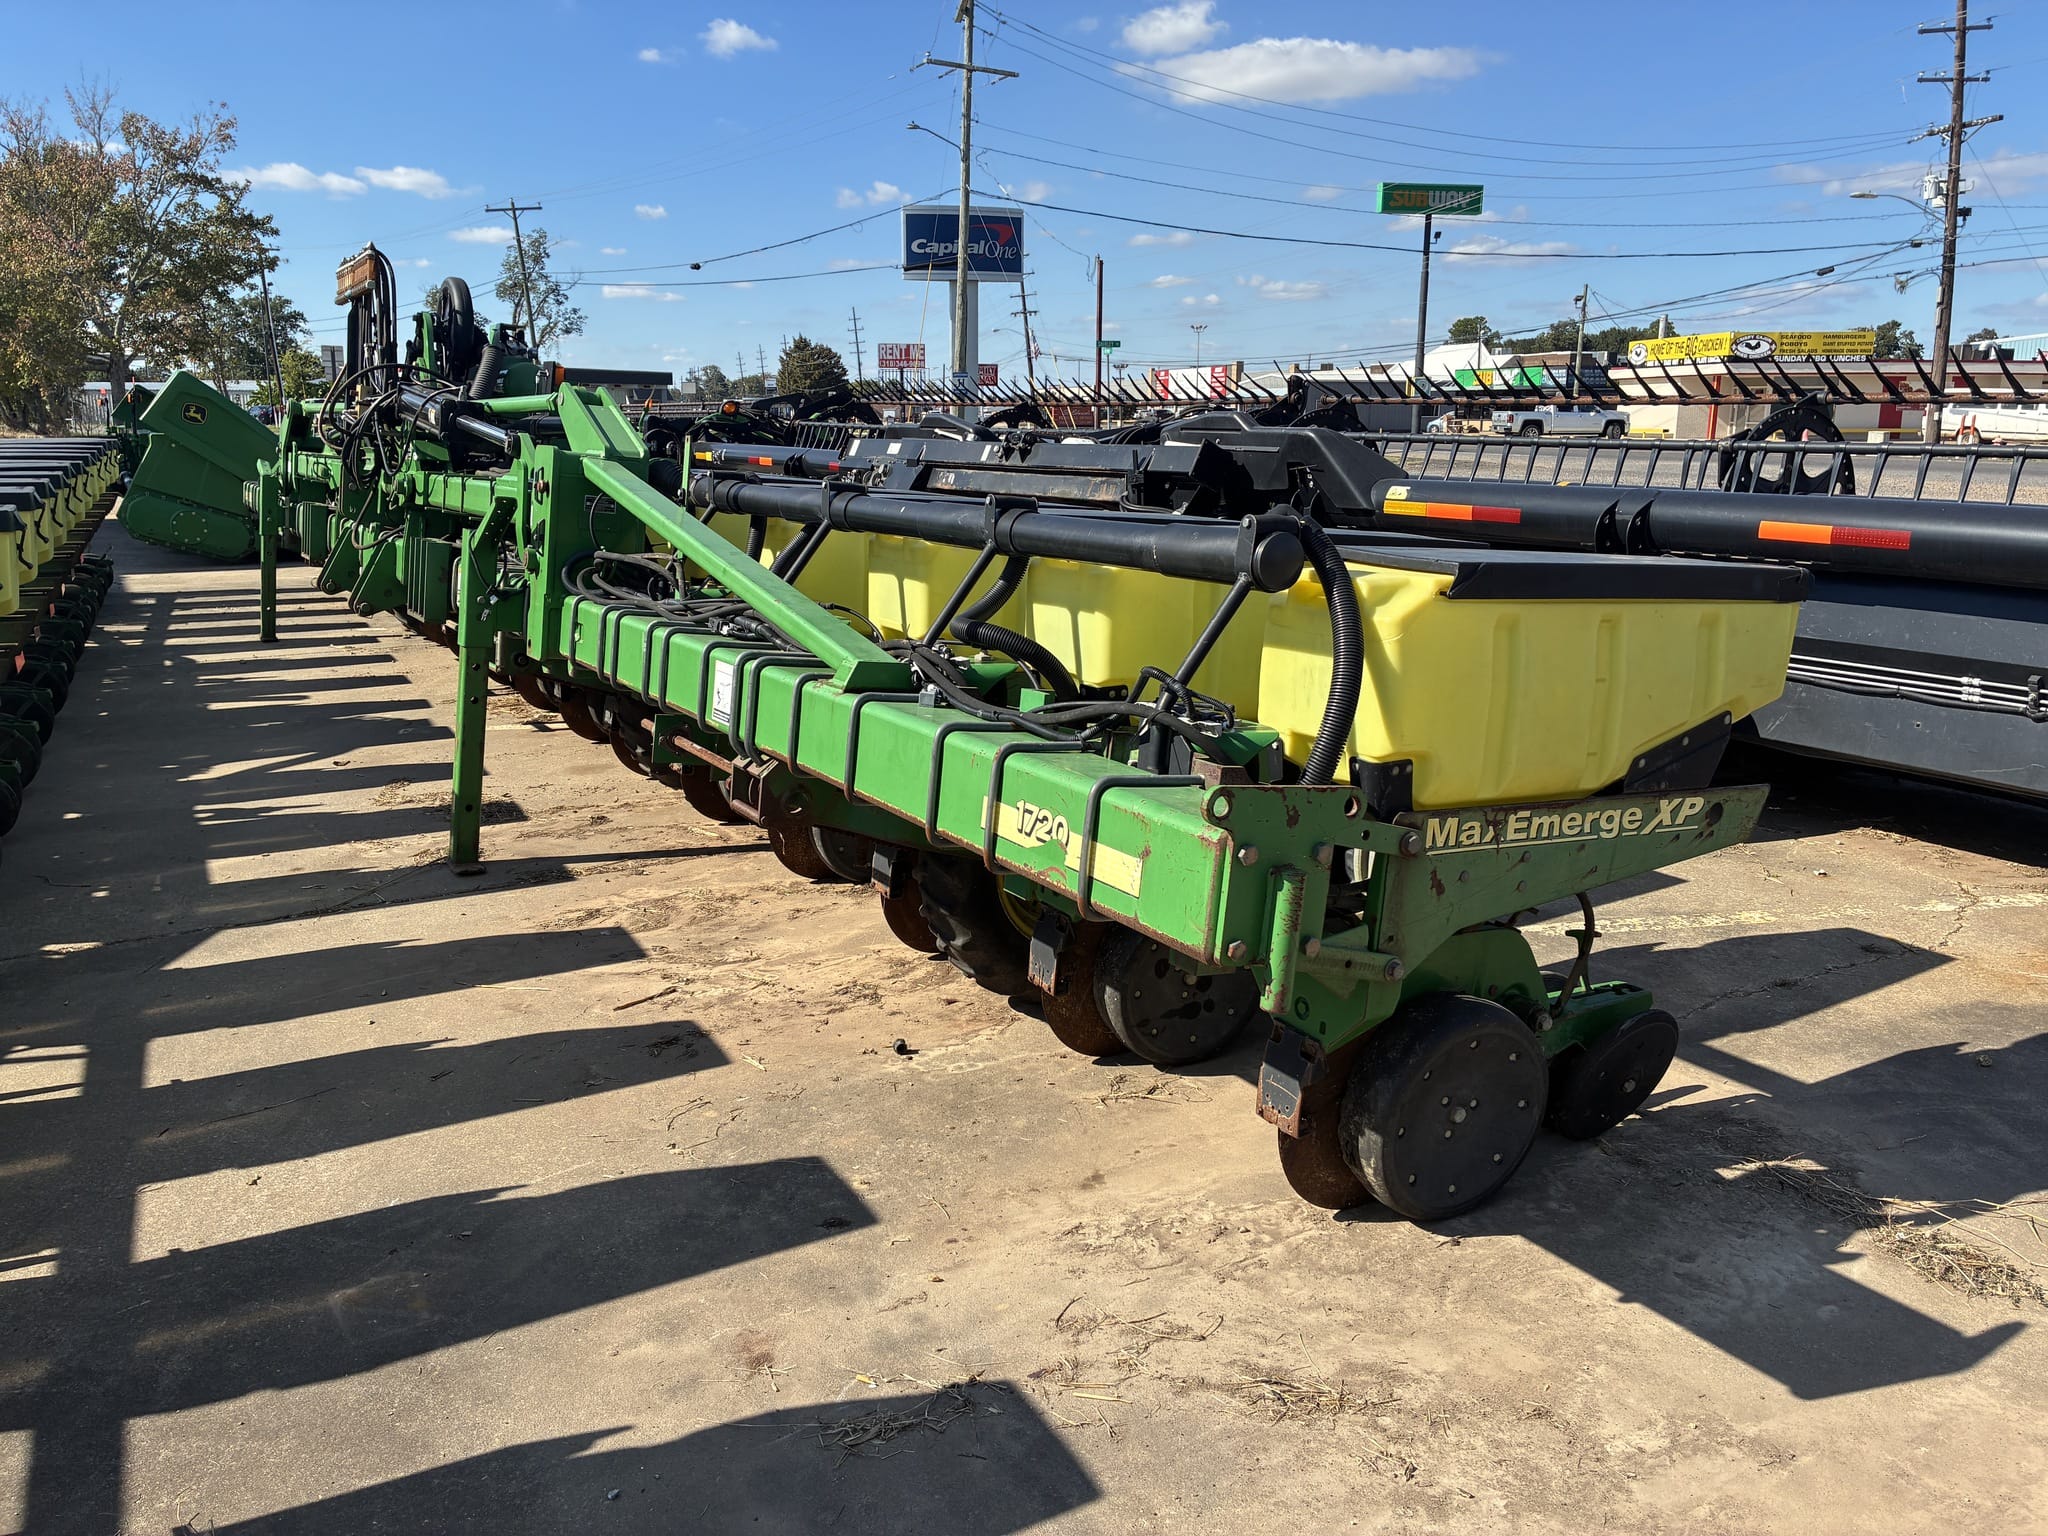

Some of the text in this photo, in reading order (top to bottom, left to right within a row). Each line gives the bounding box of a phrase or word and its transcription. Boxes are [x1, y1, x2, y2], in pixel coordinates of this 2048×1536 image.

[1389, 189, 1473, 208] SUBWAY
[911, 238, 984, 256] Capial
[879, 344, 925, 360] RENT ME
[1650, 343, 1666, 355] HOME
[1666, 342, 1674, 354] OF
[1676, 341, 1685, 354] THE
[1685, 336, 1698, 356] BIG
[1015, 799, 1069, 848] 1720
